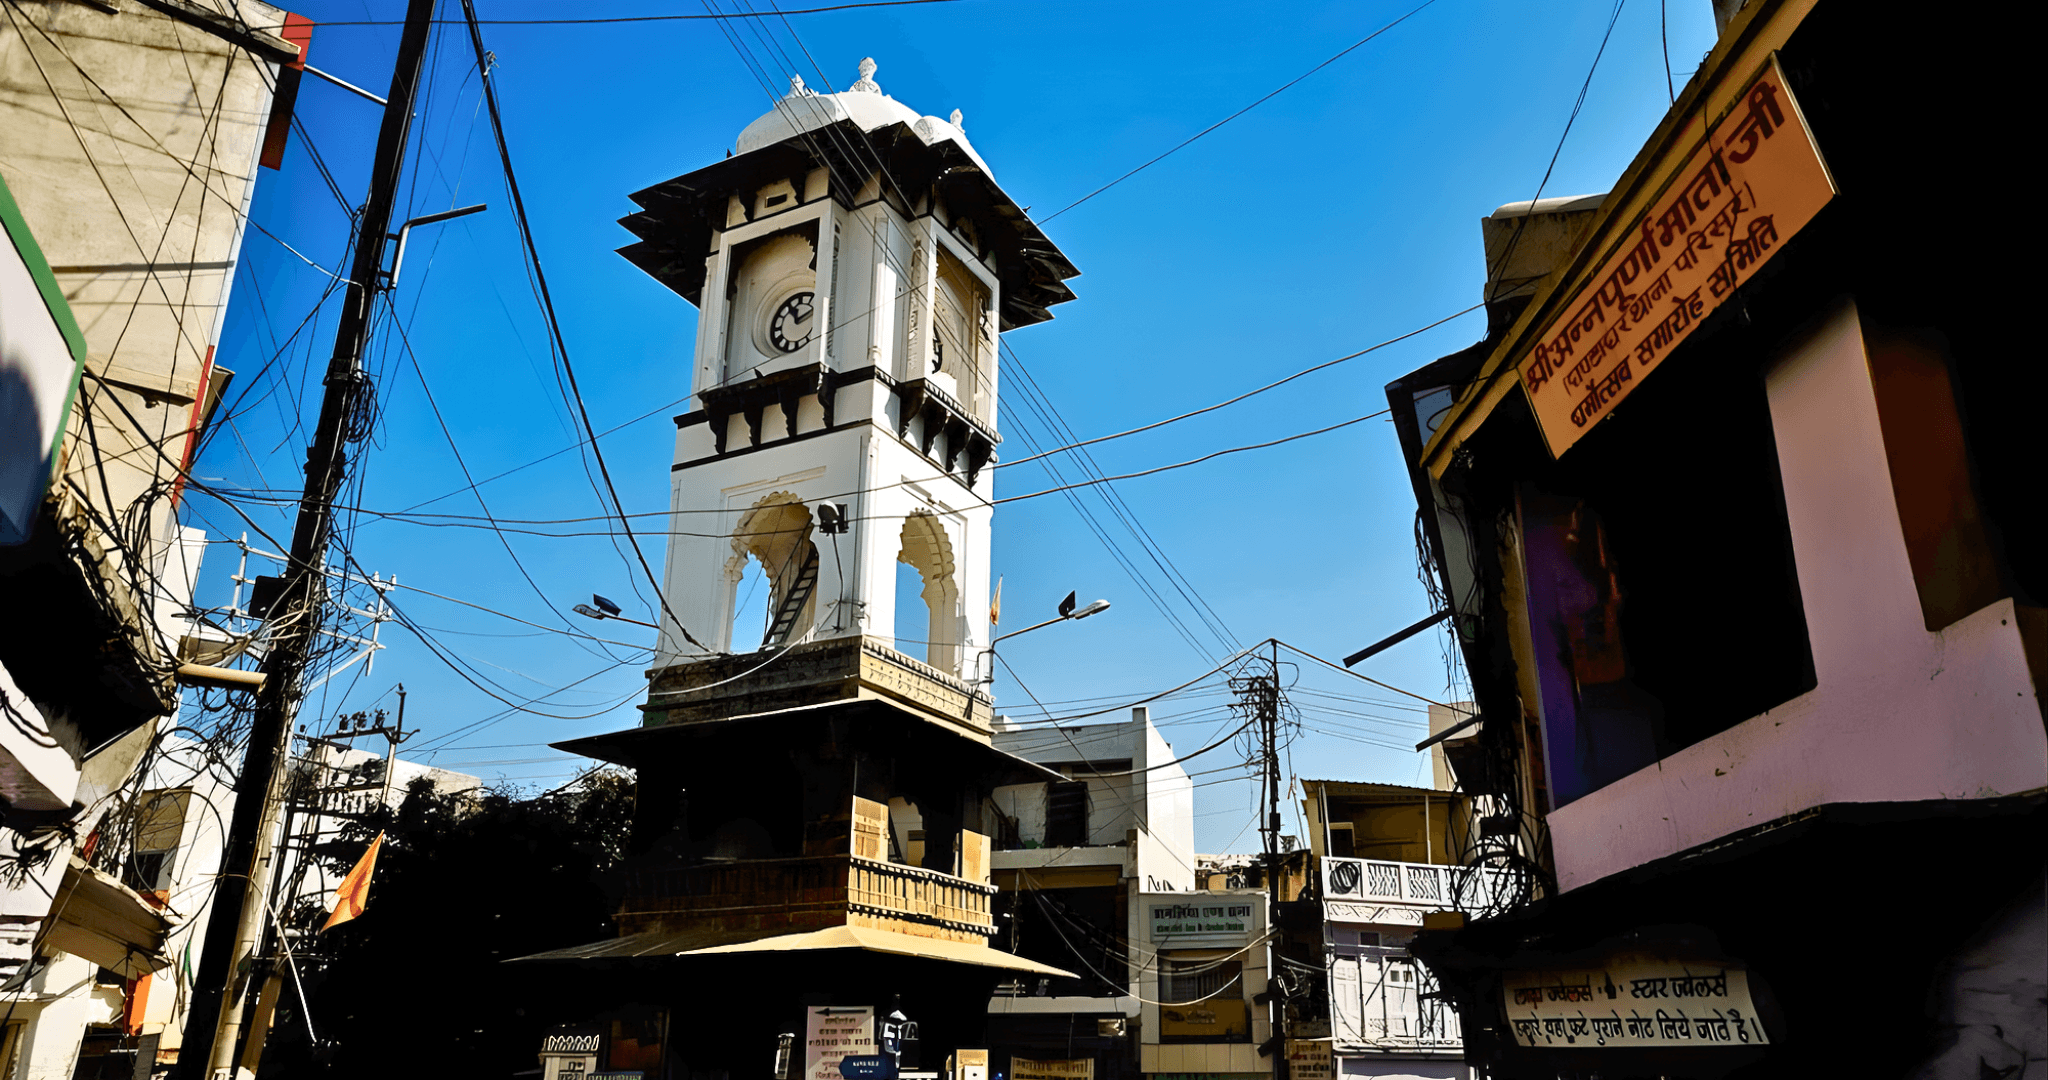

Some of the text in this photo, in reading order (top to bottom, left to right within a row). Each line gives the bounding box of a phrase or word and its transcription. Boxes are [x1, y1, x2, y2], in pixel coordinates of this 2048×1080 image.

[1570, 213, 1779, 428] धर्मोत्सव समारोह समिति
[1630, 976, 1669, 999] स्टार
[1669, 967, 1728, 998] ज्वेलर्स
[1591, 1009, 1624, 1046] पुराने
[1626, 1009, 1655, 1039] नोट
[1656, 1009, 1691, 1039] लिये
[1695, 1009, 1731, 1041] जाते
